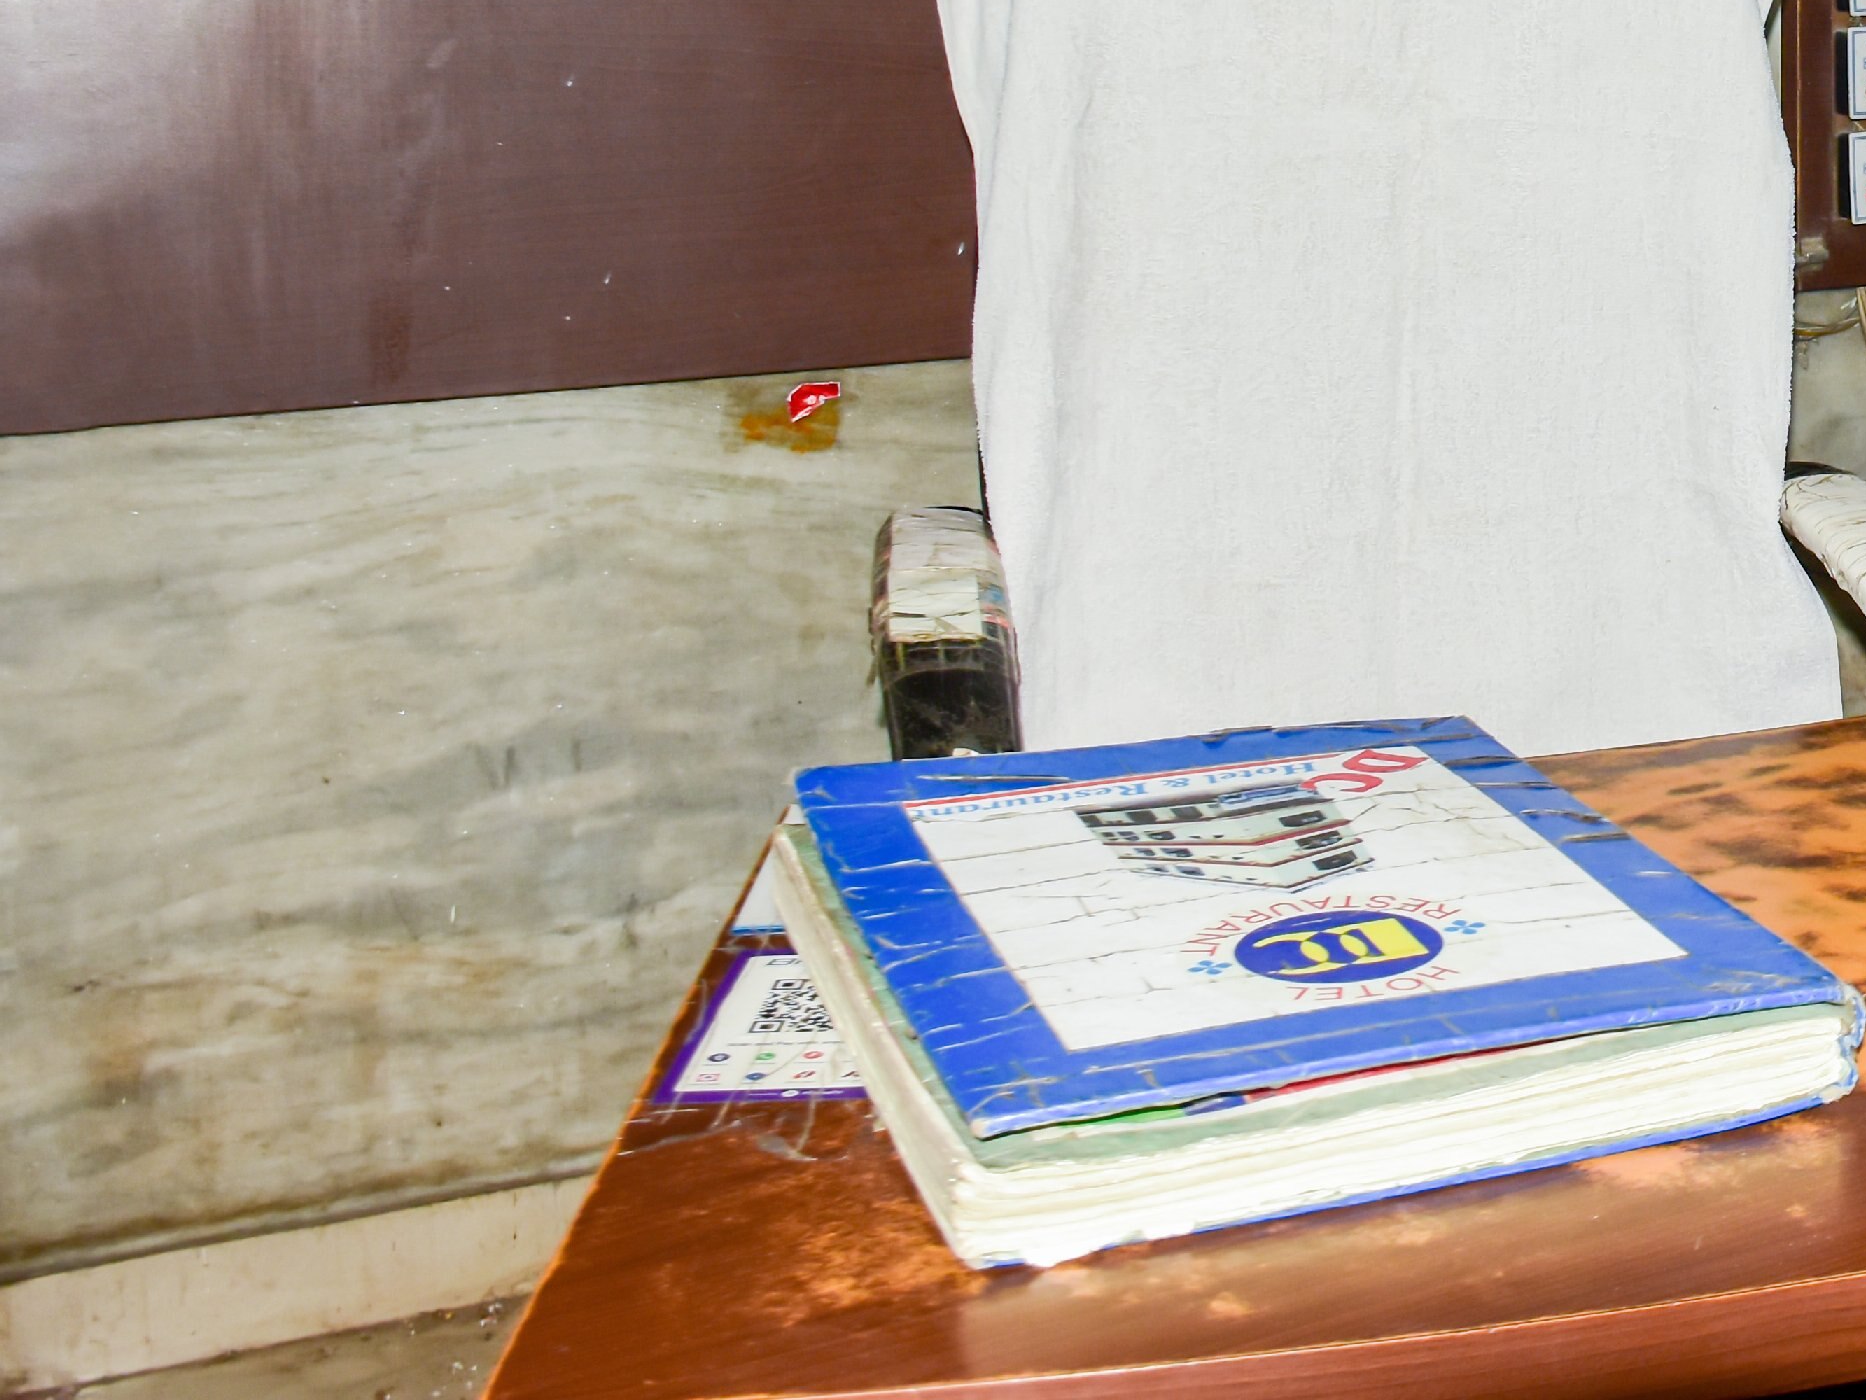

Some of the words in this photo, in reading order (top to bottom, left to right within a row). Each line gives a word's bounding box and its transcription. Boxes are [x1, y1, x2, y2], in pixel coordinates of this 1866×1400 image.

[1161, 774, 1190, 791] &
[1206, 761, 1316, 785] Hotel
[1300, 749, 1429, 793] DC
[912, 781, 1147, 817] Restaurant
[1180, 895, 1462, 957] RESTAURANT
[1252, 917, 1430, 976] DC
[1285, 964, 1461, 1001] HOTEL
